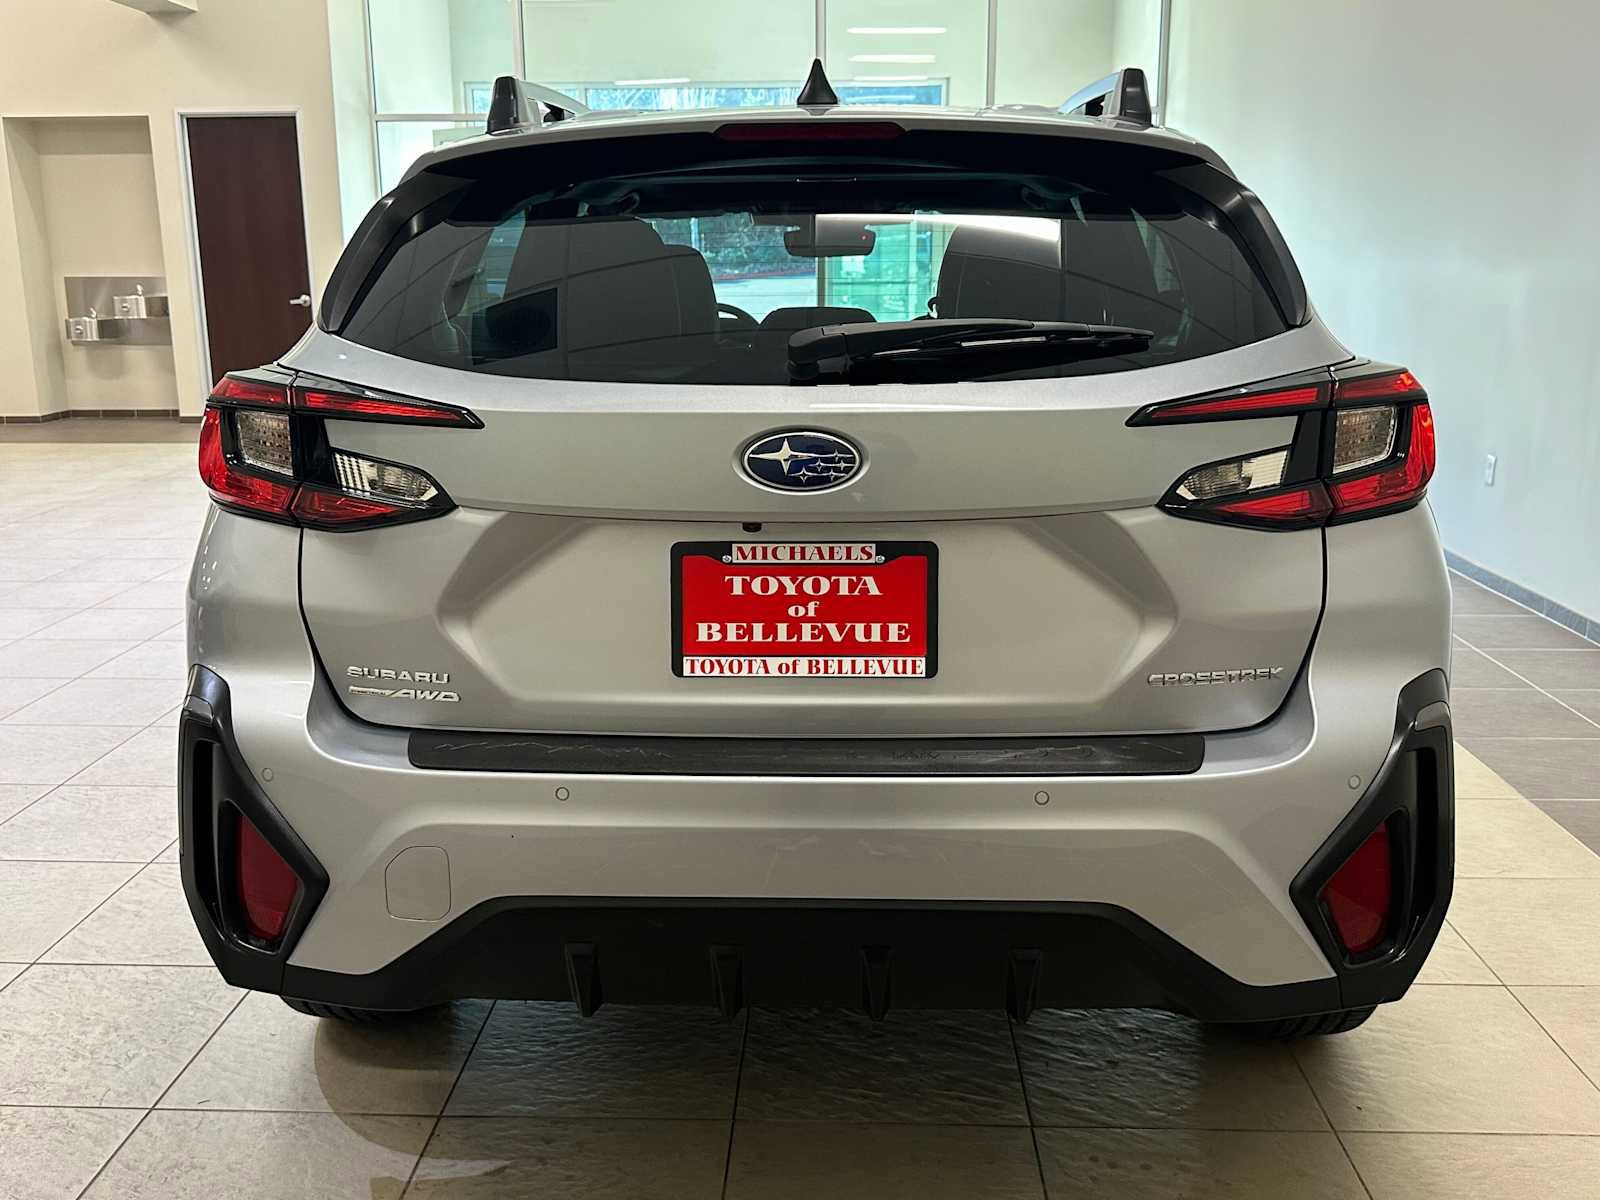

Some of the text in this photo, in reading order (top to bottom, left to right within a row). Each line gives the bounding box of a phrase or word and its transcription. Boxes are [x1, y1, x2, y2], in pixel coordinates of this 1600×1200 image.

[736, 546, 873, 561] MICHAELS
[725, 576, 883, 596] TOYOTA
[787, 601, 820, 617] of
[696, 622, 911, 643] BELLEVUE
[347, 666, 449, 684] SUBARU
[686, 659, 924, 675] TOYOTA of BELLEVUE
[1148, 667, 1284, 686] CROSSTREK
[388, 688, 460, 702] AWD
